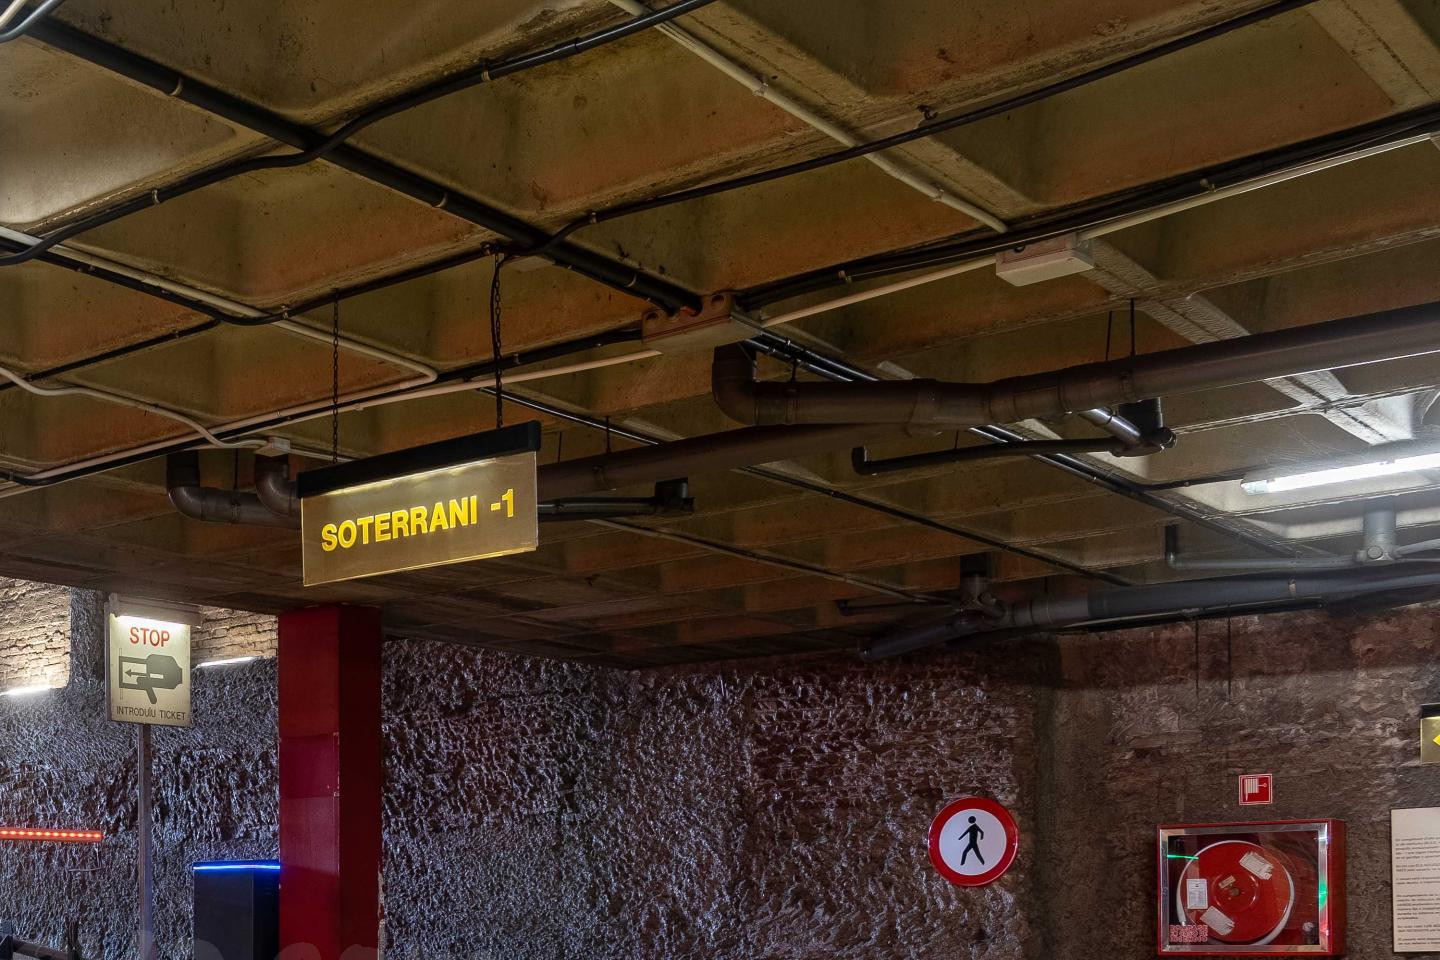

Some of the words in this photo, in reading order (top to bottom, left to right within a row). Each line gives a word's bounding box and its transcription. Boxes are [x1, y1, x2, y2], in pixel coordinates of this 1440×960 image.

[321, 495, 478, 552] SOTERRANI
[490, 488, 515, 518] -1
[129, 627, 170, 647] STOP
[160, 709, 186, 721] TICKET
